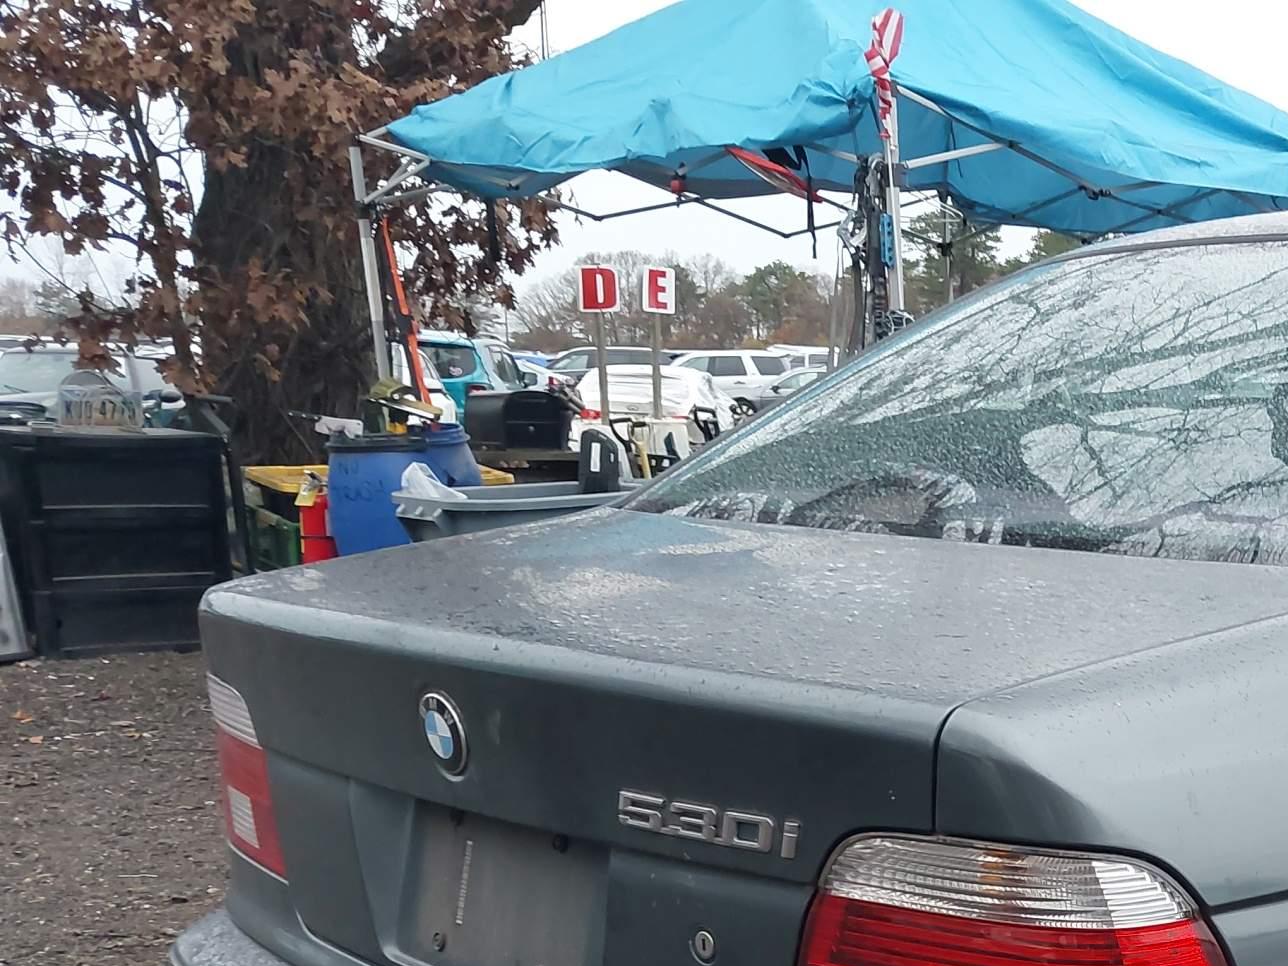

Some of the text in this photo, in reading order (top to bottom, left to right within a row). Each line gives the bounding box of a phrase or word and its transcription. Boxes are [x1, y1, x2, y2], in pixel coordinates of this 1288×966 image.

[580, 268, 617, 310] D
[647, 268, 668, 310] E
[618, 790, 801, 859] 530i
